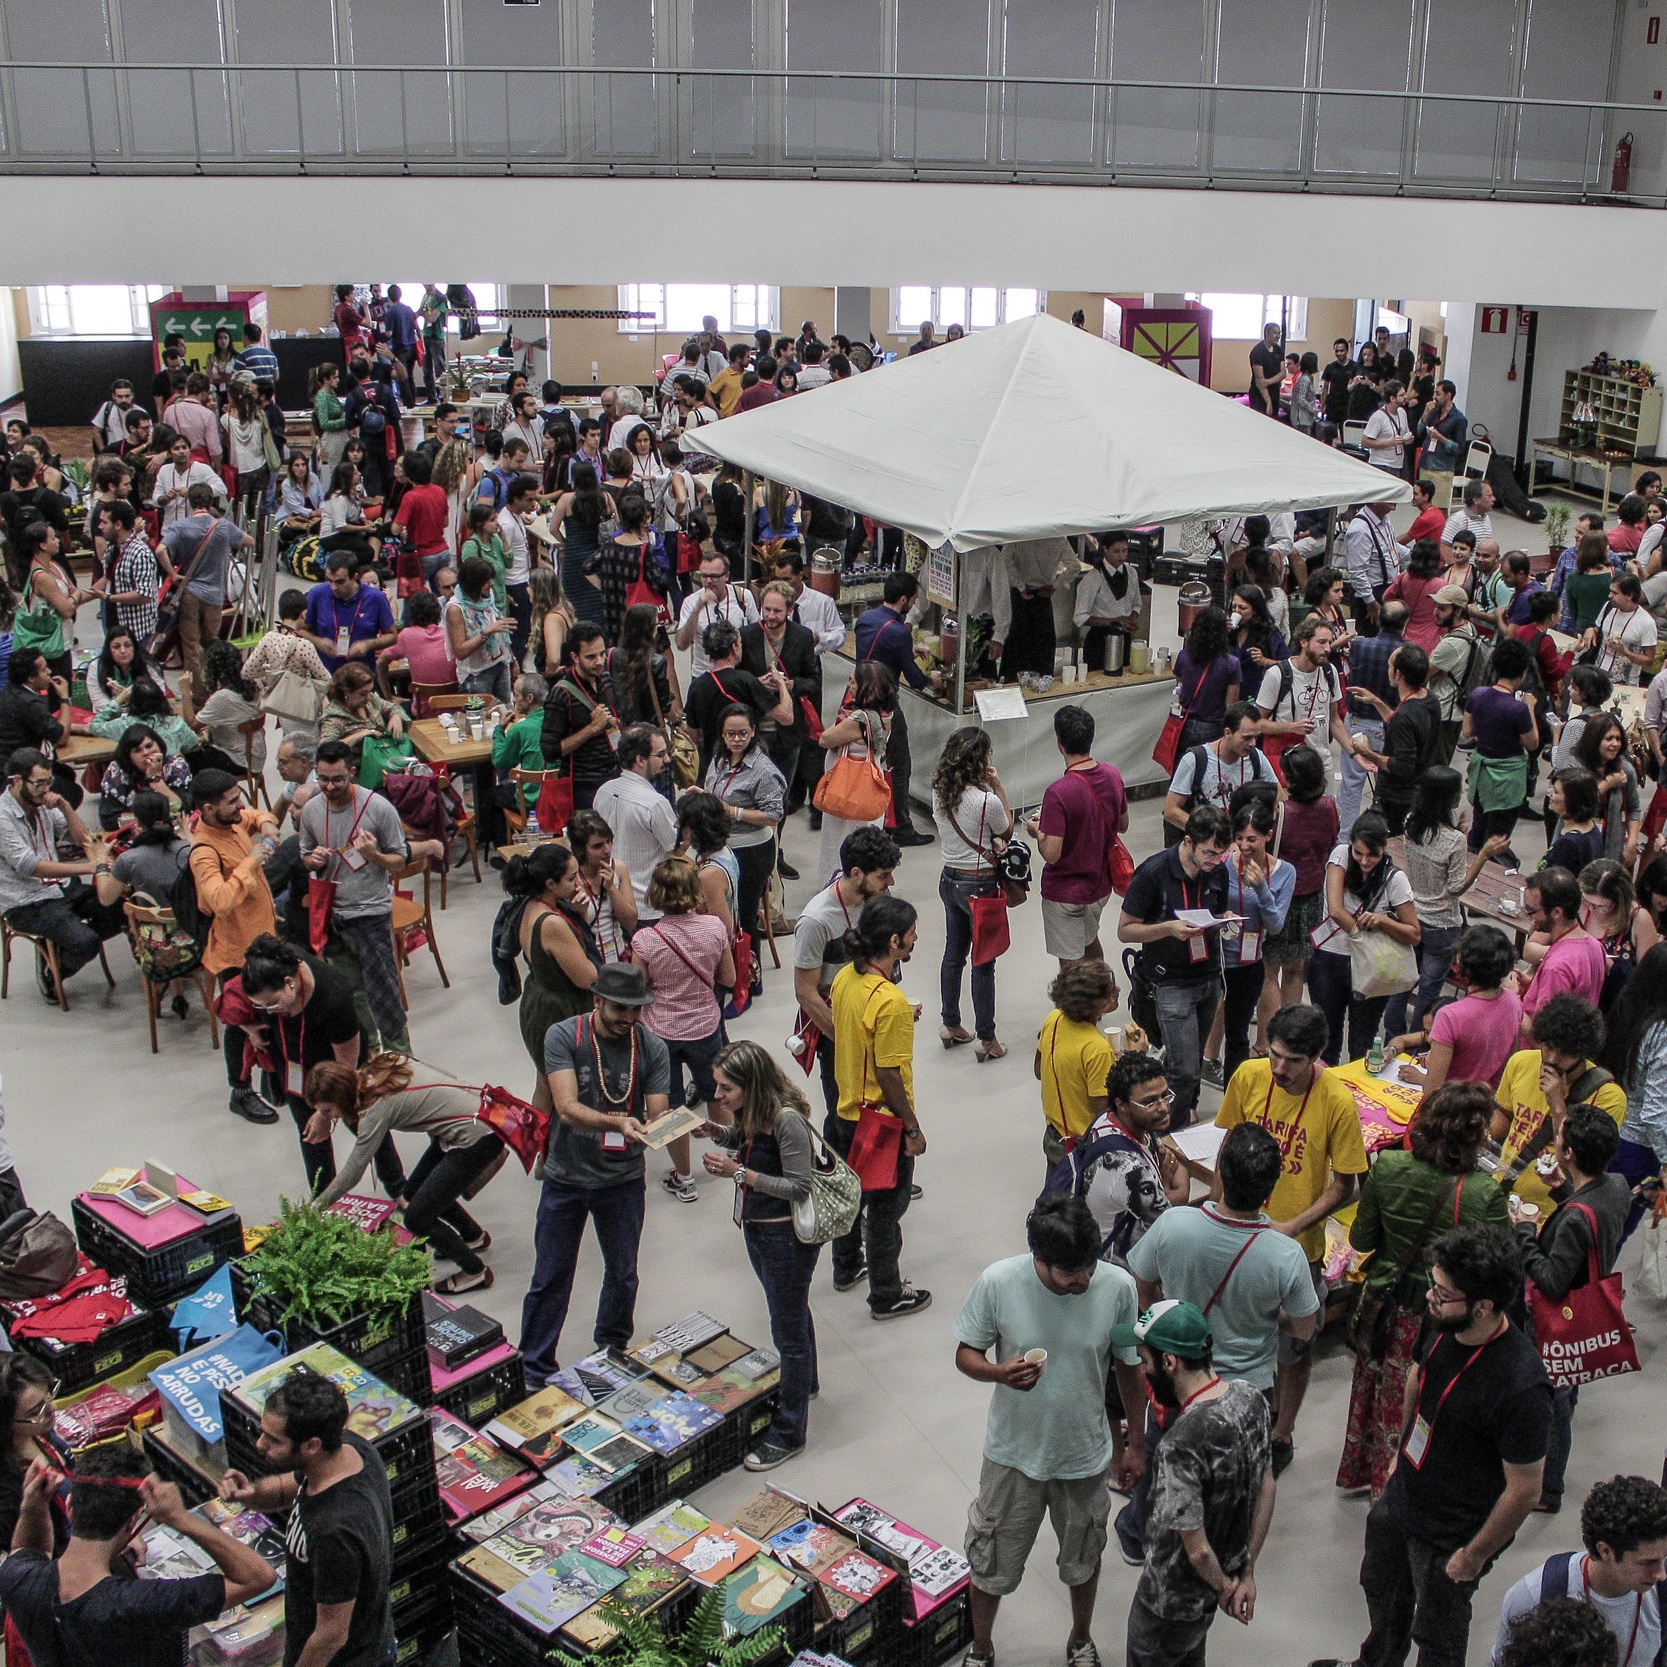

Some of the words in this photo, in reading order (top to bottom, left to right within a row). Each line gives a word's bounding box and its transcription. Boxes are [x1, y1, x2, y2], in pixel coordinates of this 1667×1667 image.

[1255, 1114, 1308, 1145] TARIFA
[1542, 1329, 1621, 1358] #ÔNIBUS
[175, 1366, 201, 1384] NO
[1542, 1357, 1584, 1374] SEM
[157, 1374, 221, 1433] ARRUDAS
[584, 1544, 620, 1563] TENSION
[594, 1537, 630, 1555] PASSION
